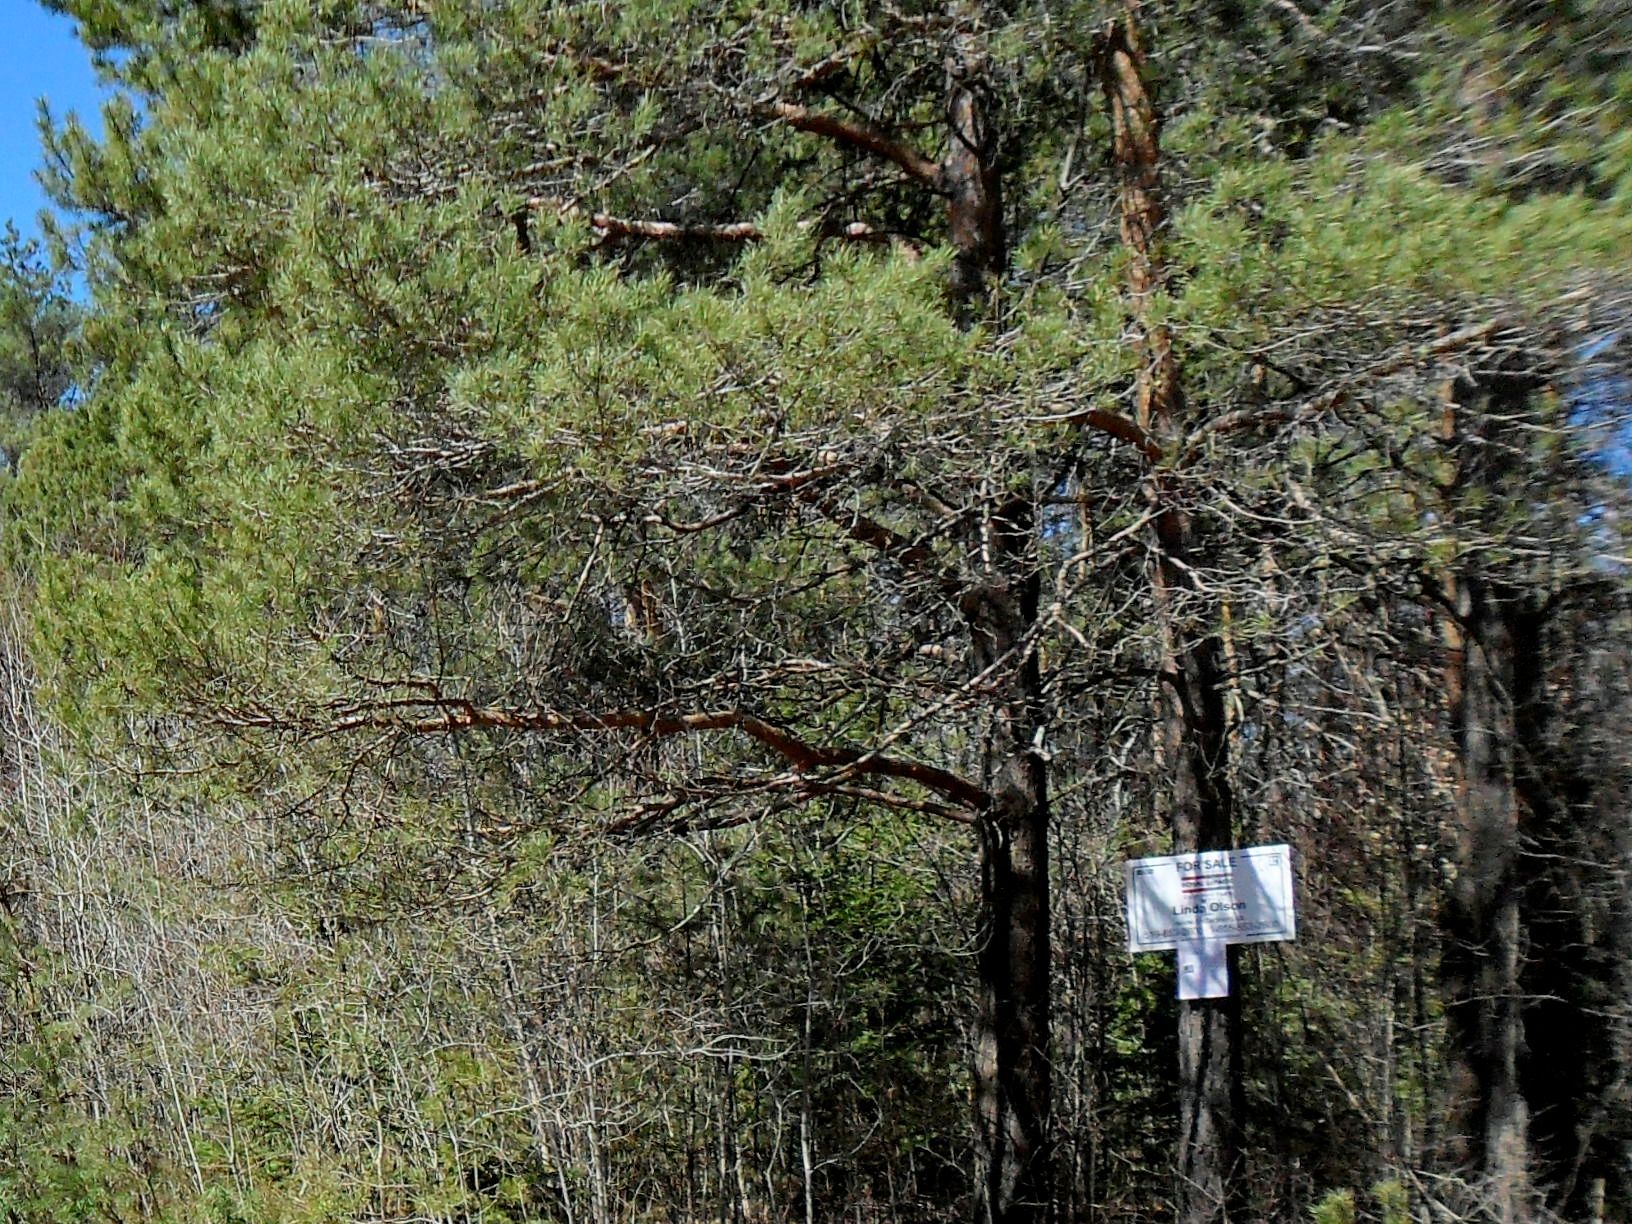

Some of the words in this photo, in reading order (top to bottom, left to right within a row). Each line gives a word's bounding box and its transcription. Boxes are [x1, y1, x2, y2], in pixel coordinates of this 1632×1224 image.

[1176, 860, 1201, 872] FOR
[1204, 856, 1238, 869] SALE
[1172, 904, 1205, 915] Linda
[1209, 901, 1246, 913] Olson
